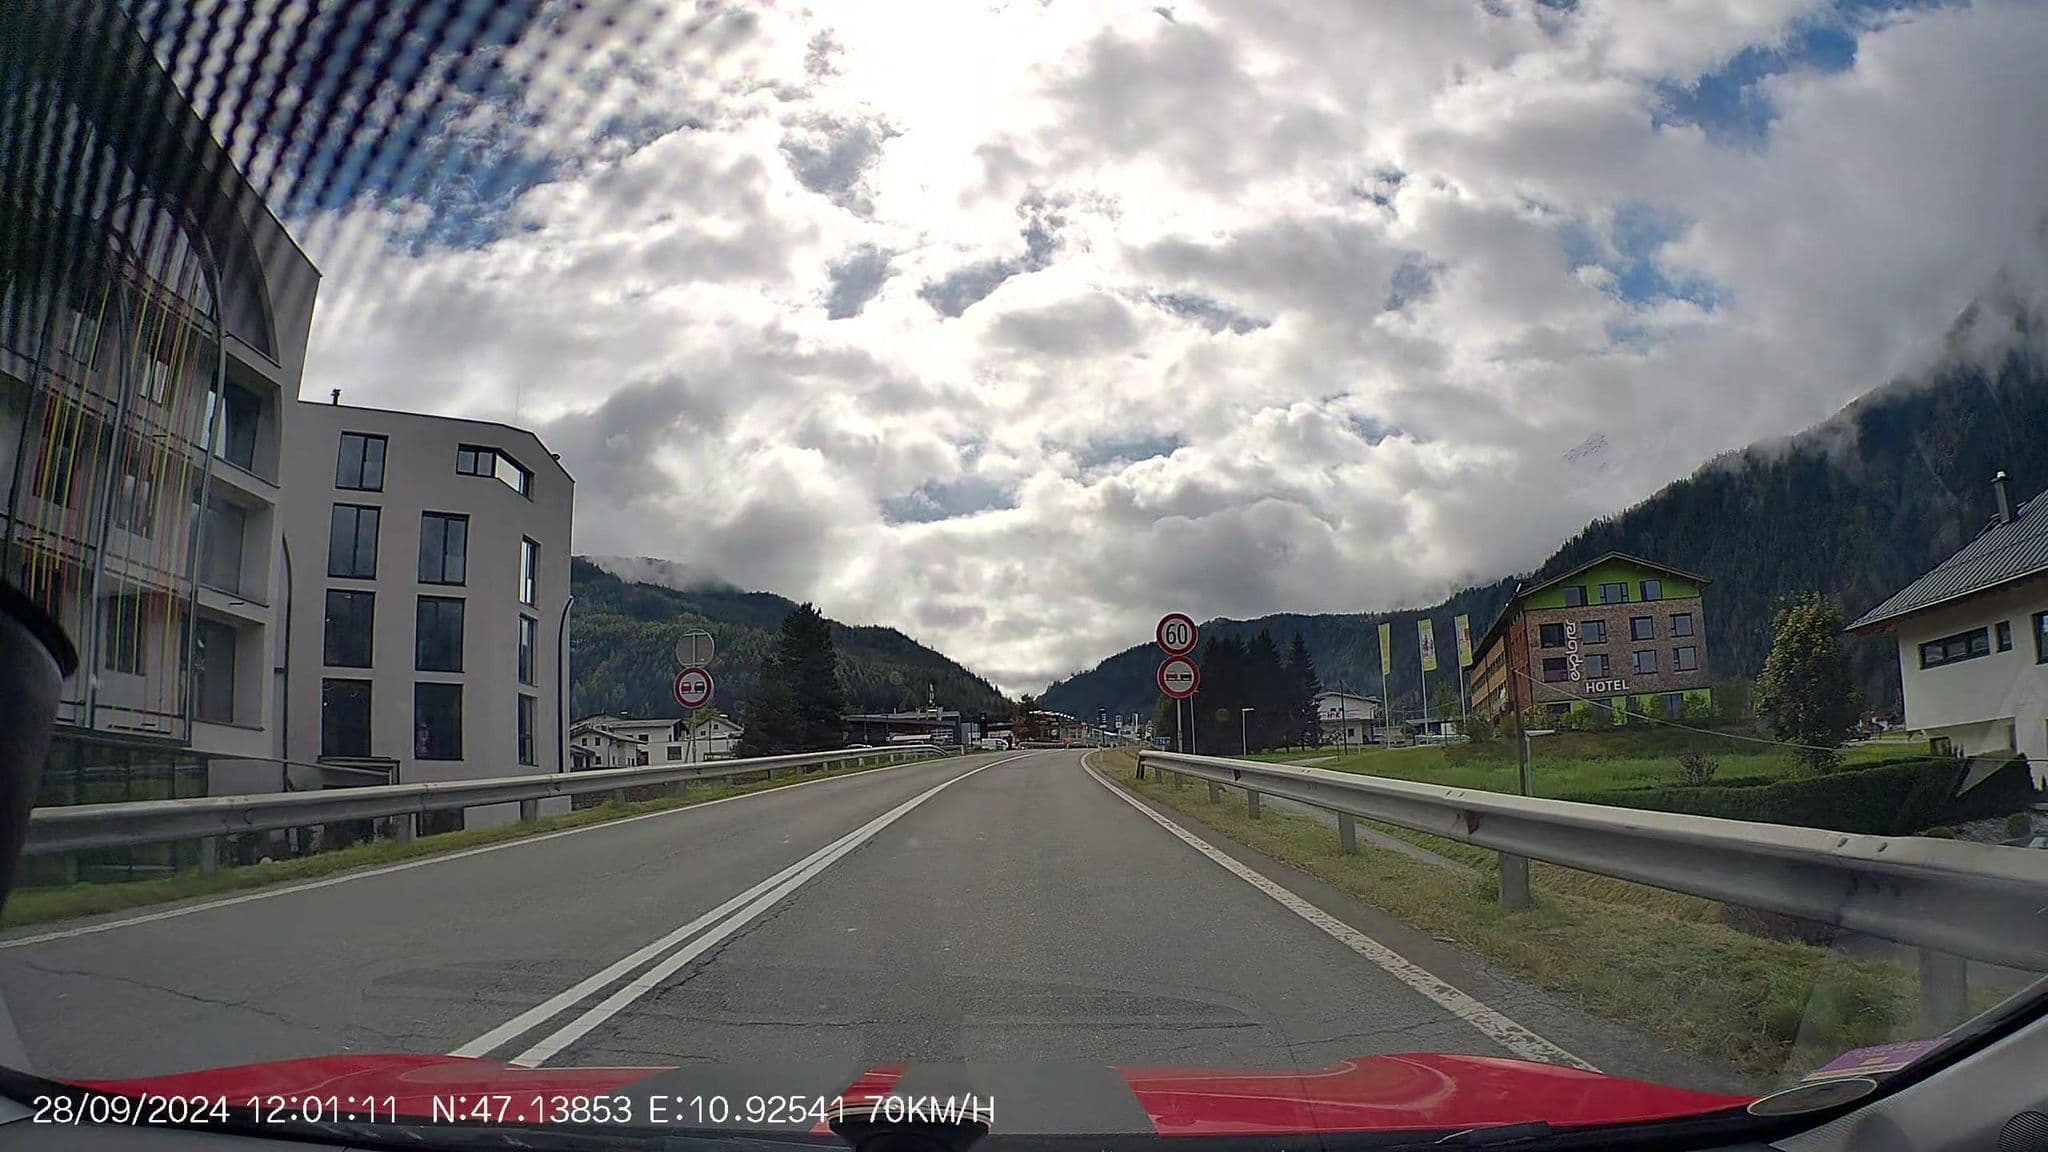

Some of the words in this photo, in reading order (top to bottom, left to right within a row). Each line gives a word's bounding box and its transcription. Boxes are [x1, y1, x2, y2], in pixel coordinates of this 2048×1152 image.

[1166, 623, 1188, 645] 60
[1565, 619, 1584, 681] explorer
[1585, 680, 1630, 693] HOTEL
